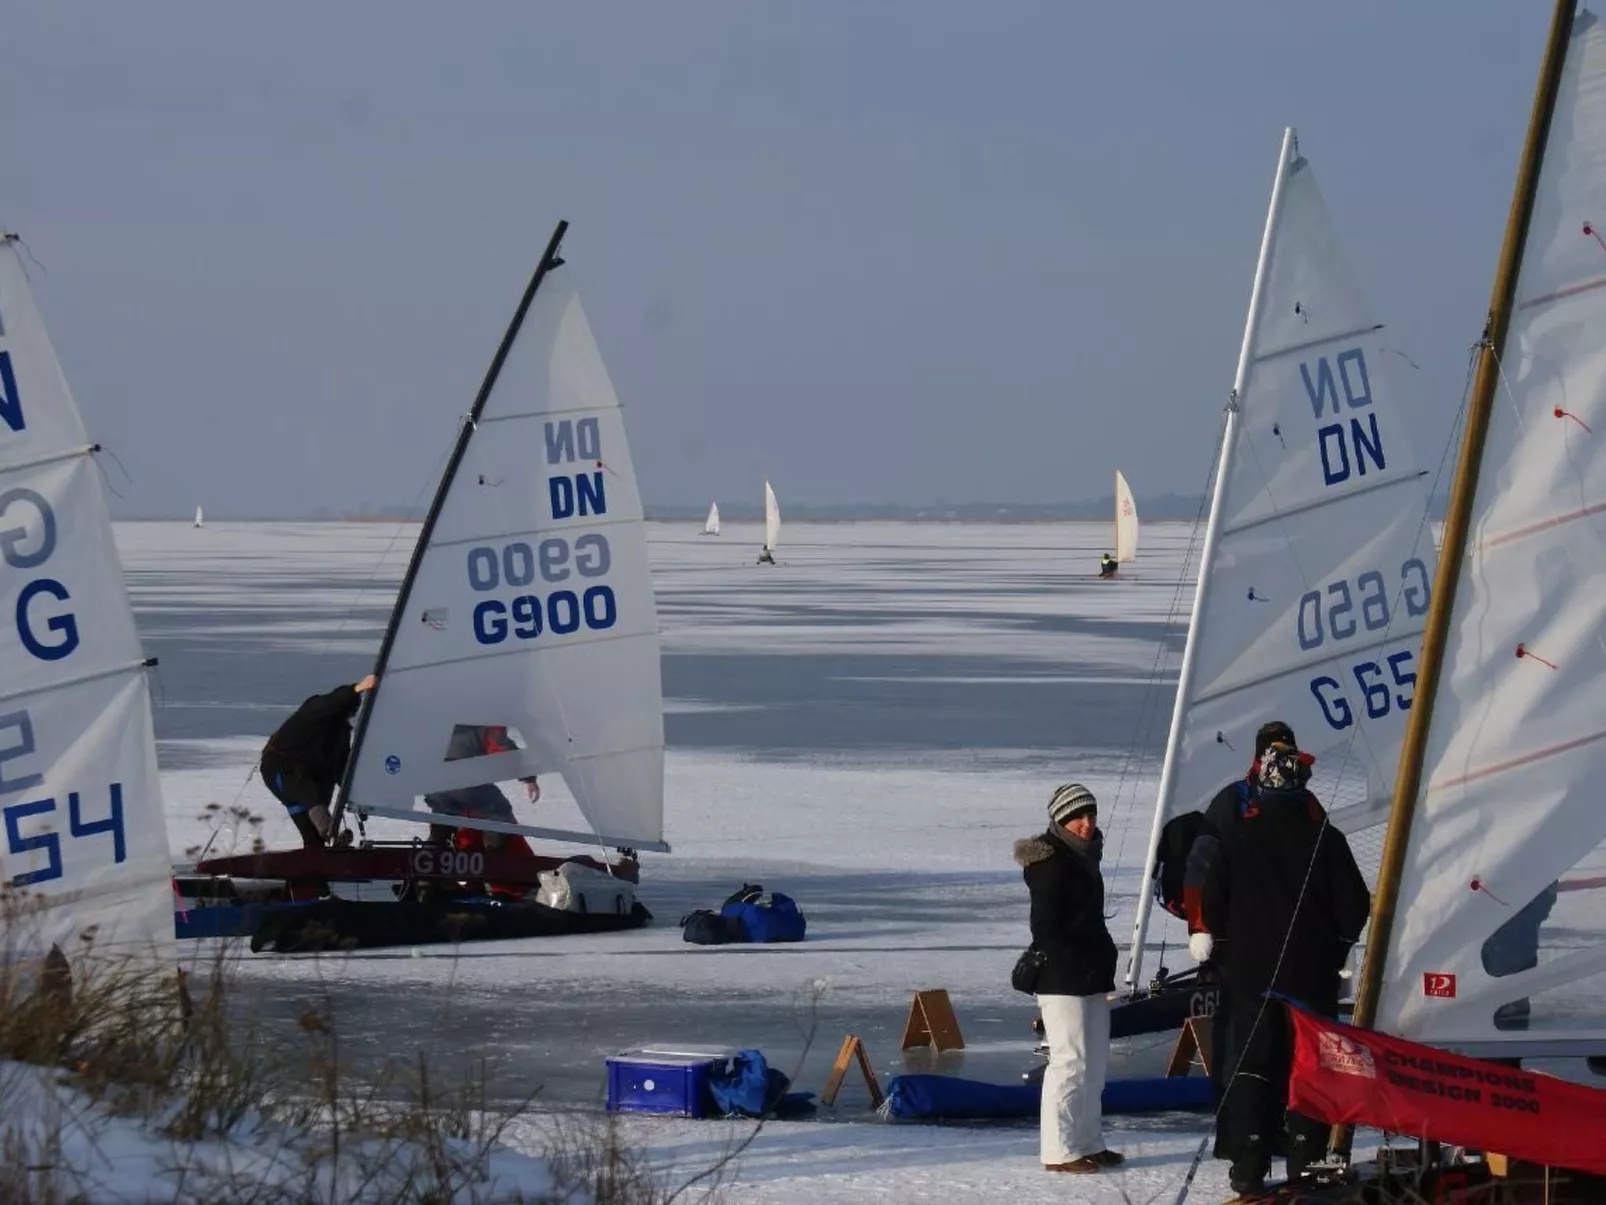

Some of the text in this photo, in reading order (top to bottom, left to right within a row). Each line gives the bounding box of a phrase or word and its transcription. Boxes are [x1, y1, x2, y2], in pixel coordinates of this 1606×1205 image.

[1319, 413, 1385, 486] DN
[549, 472, 607, 519] DN
[16, 578, 80, 661] G
[473, 585, 617, 645] G900
[1310, 676, 1353, 730] G
[3, 783, 126, 887] 54
[414, 850, 483, 875] G 900
[1386, 1069, 1481, 1102] DESIGN
